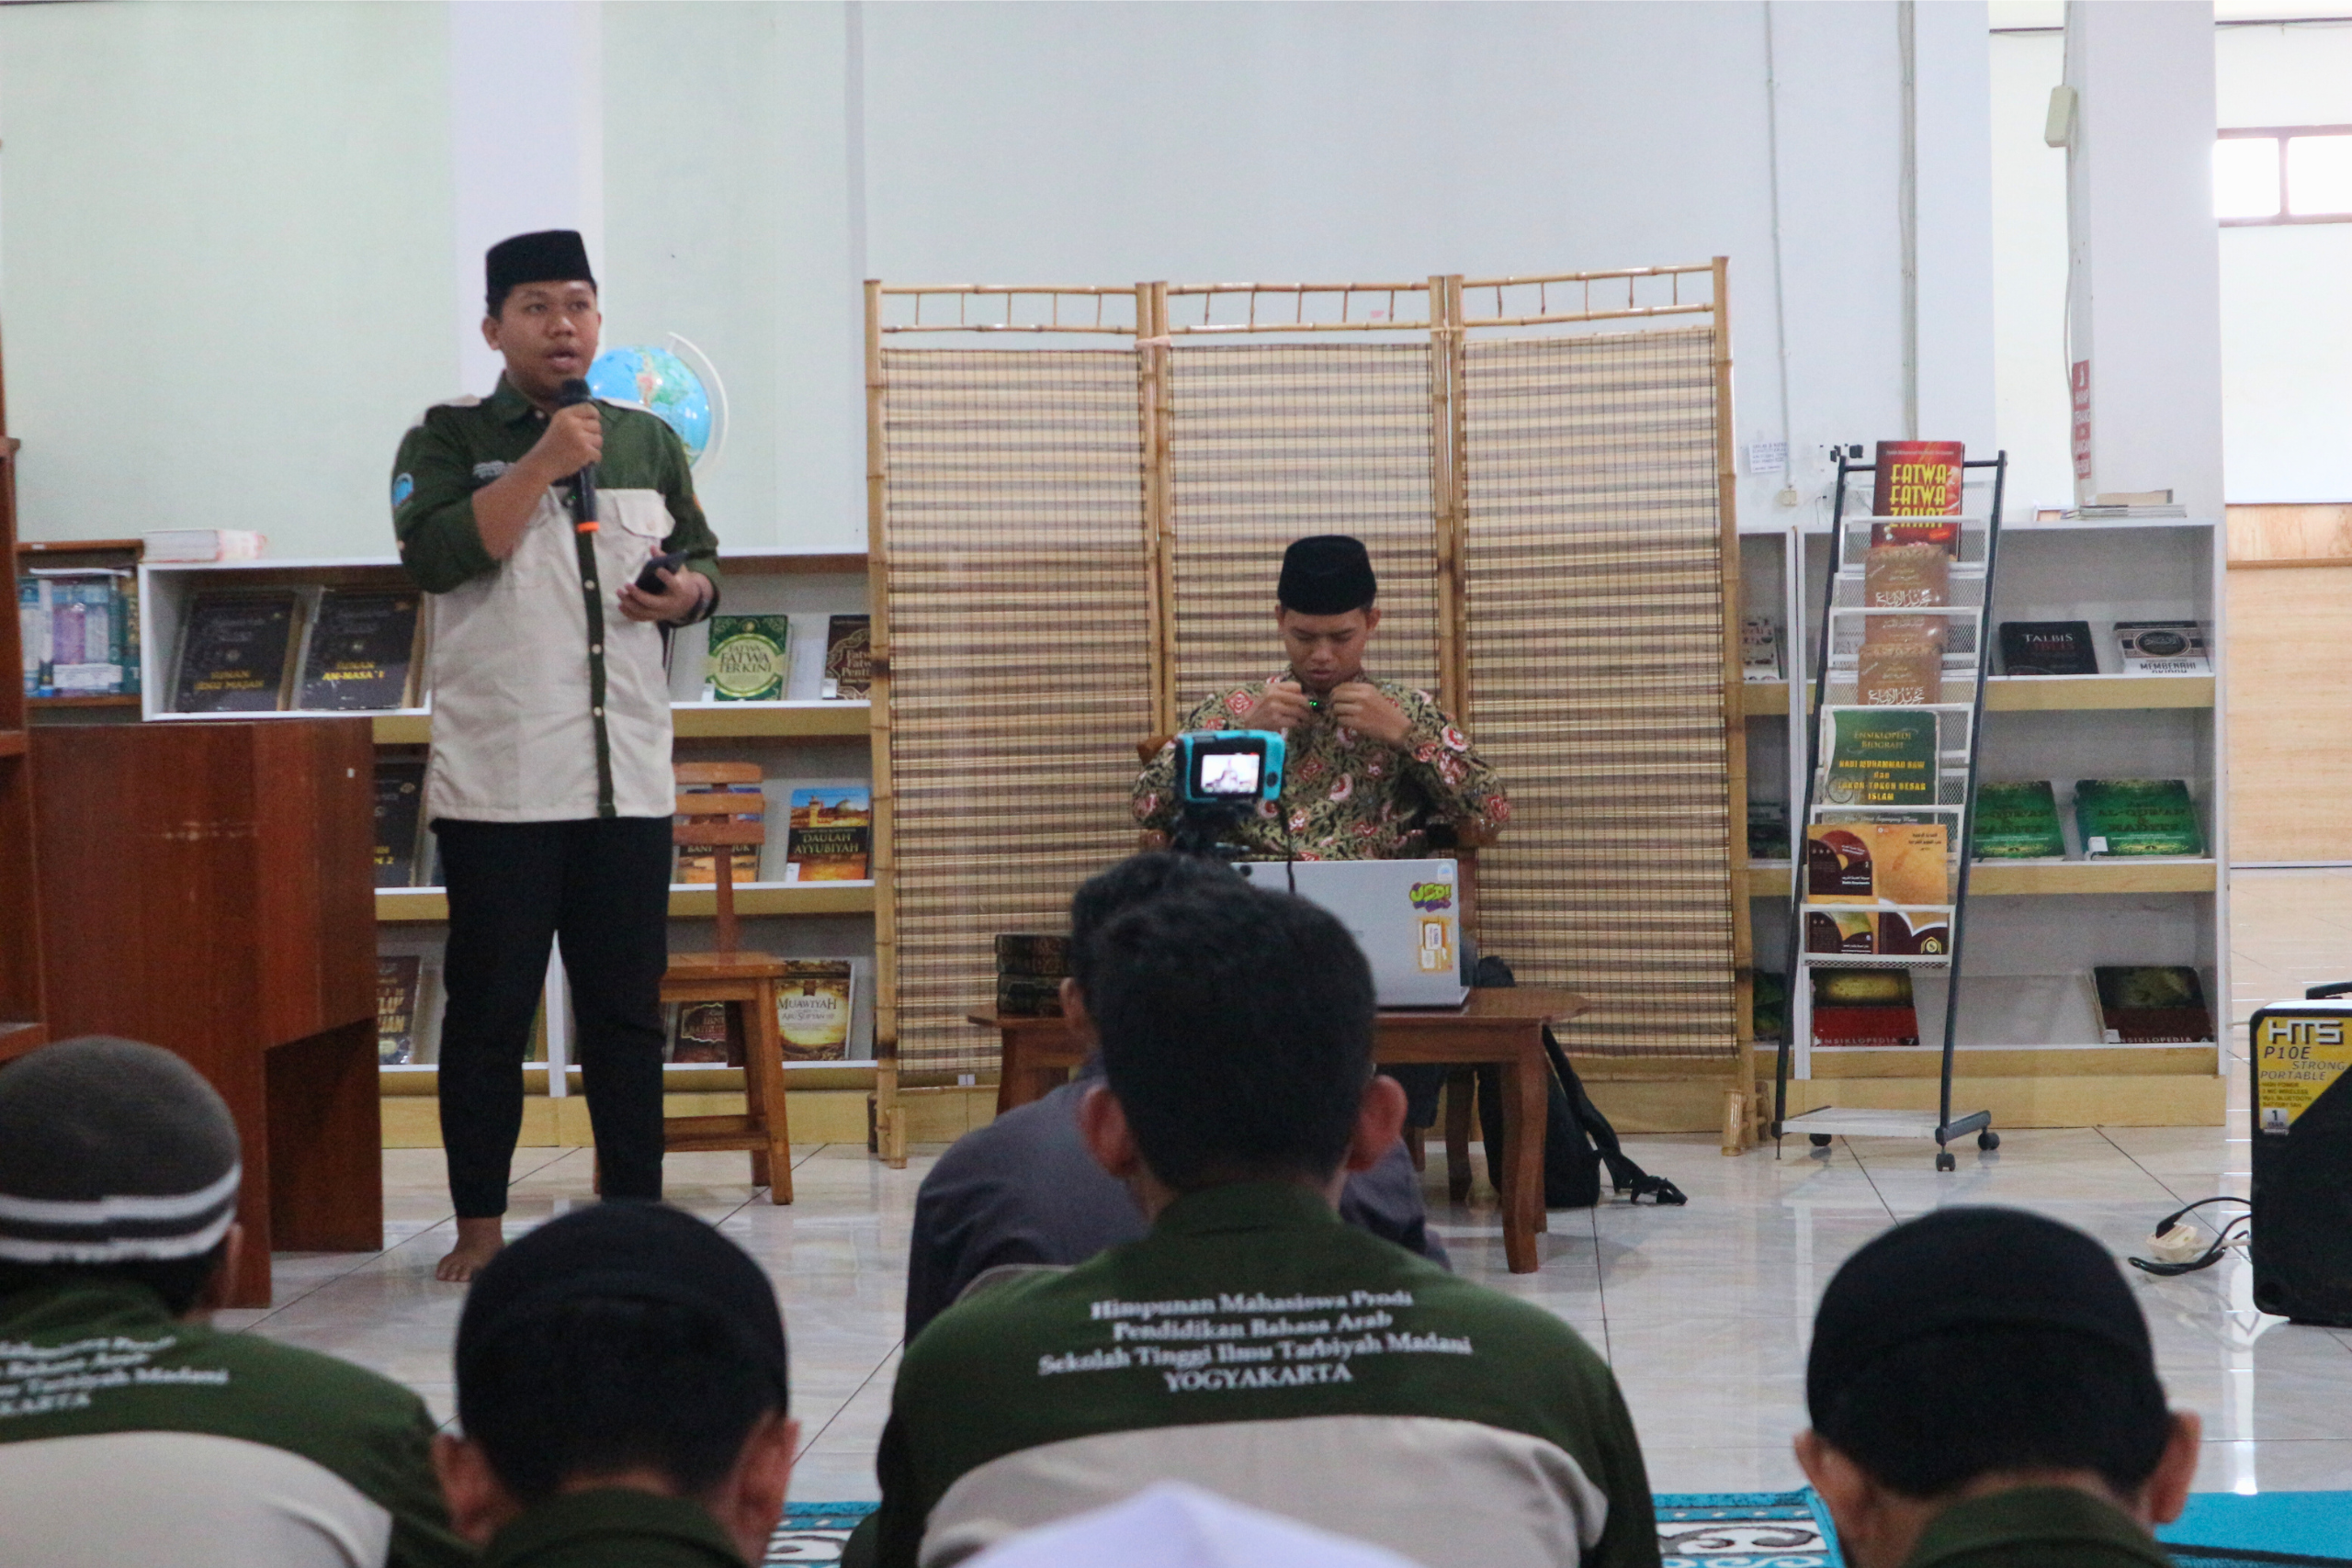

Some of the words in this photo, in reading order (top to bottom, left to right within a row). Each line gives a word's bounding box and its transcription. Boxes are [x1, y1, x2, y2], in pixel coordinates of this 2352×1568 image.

[1890, 485, 1946, 506] FATWA
[2023, 633, 2073, 642] TALBIS
[721, 652, 770, 663] FATWA
[718, 663, 772, 673] TERKINI
[2140, 661, 2197, 671] MEMBENAHI
[803, 833, 851, 843] DAULAH
[795, 842, 859, 853] AYYUBIYAH
[779, 998, 837, 1010] MUAWIYAH
[2267, 1020, 2344, 1044] HTS
[2264, 1046, 2311, 1059] P10E
[2292, 1061, 2346, 1070] STRONG
[2260, 1071, 2326, 1080] PORTABLE
[2272, 1110, 2278, 1121] 1
[1351, 1289, 1414, 1308] Prodi
[1113, 1318, 1245, 1341] Pendidikan
[1250, 1316, 1330, 1338] Bahasa
[1336, 1309, 1393, 1331] Arab
[1133, 1344, 1213, 1370] Tinggi
[1217, 1342, 1273, 1363] Ilmu
[1385, 1331, 1473, 1355] Madani
[1162, 1361, 1353, 1393] YOGYAKARTA
